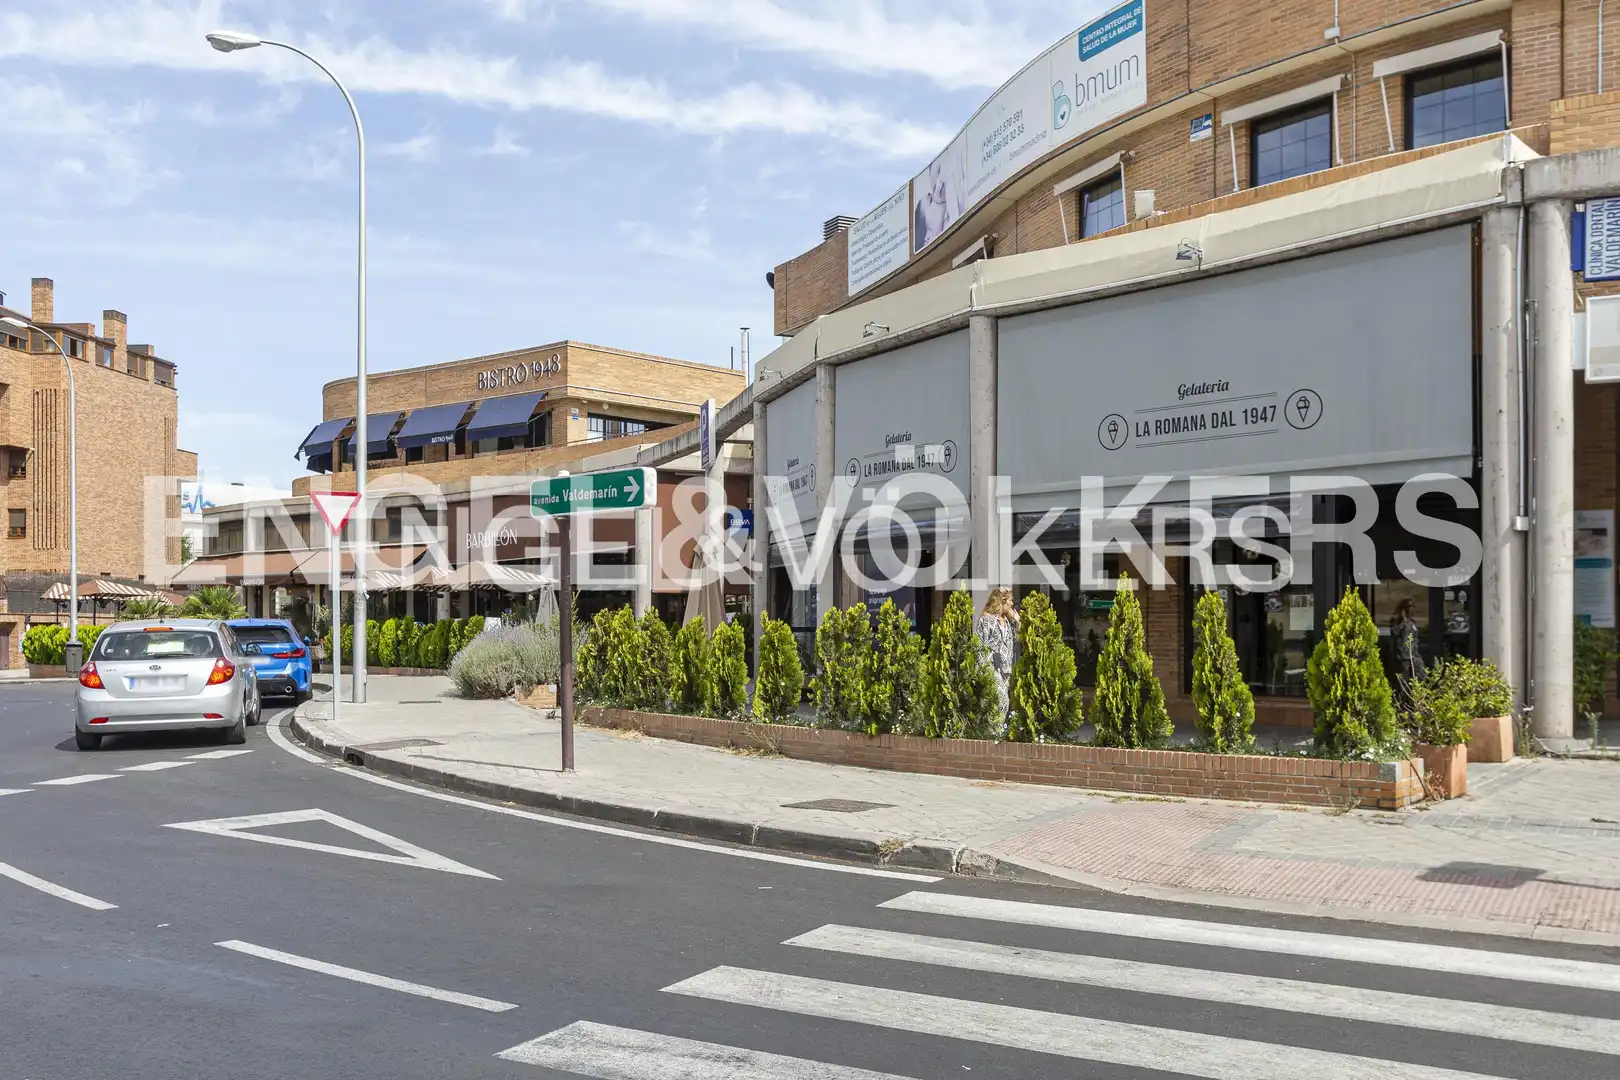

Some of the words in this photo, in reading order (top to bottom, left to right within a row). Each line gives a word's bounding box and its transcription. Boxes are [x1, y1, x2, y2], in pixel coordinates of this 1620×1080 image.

[1082, 27, 1104, 44] CENTRO
[1104, 12, 1133, 32] INTEGRAL
[1133, 6, 1142, 17] DE
[1082, 39, 1101, 54] SALUD
[1100, 34, 1109, 44] DE
[1109, 30, 1117, 40] LA
[1117, 19, 1138, 35] MUJER
[1075, 54, 1139, 107] bmum
[1002, 116, 1012, 132] 570
[1012, 108, 1023, 124] 591
[1591, 200, 1604, 237] DENTAL
[1604, 199, 1620, 274] VALDEMARÍN
[1589, 239, 1603, 276] CLÍNICA
[530, 353, 561, 381] 1948
[1177, 379, 1230, 401] Gelateria
[1135, 421, 1150, 438] LA
[1155, 412, 1207, 436] ROMANA
[1211, 409, 1236, 429] DAL
[1242, 404, 1278, 425] 1947
[885, 430, 912, 449] Gelateria
[864, 463, 872, 478] LA
[873, 459, 901, 476] ROMANA
[901, 456, 915, 471] DAL
[533, 494, 560, 505] avenida
[562, 485, 618, 503] Valdemarín
[730, 518, 751, 526] BBVA
